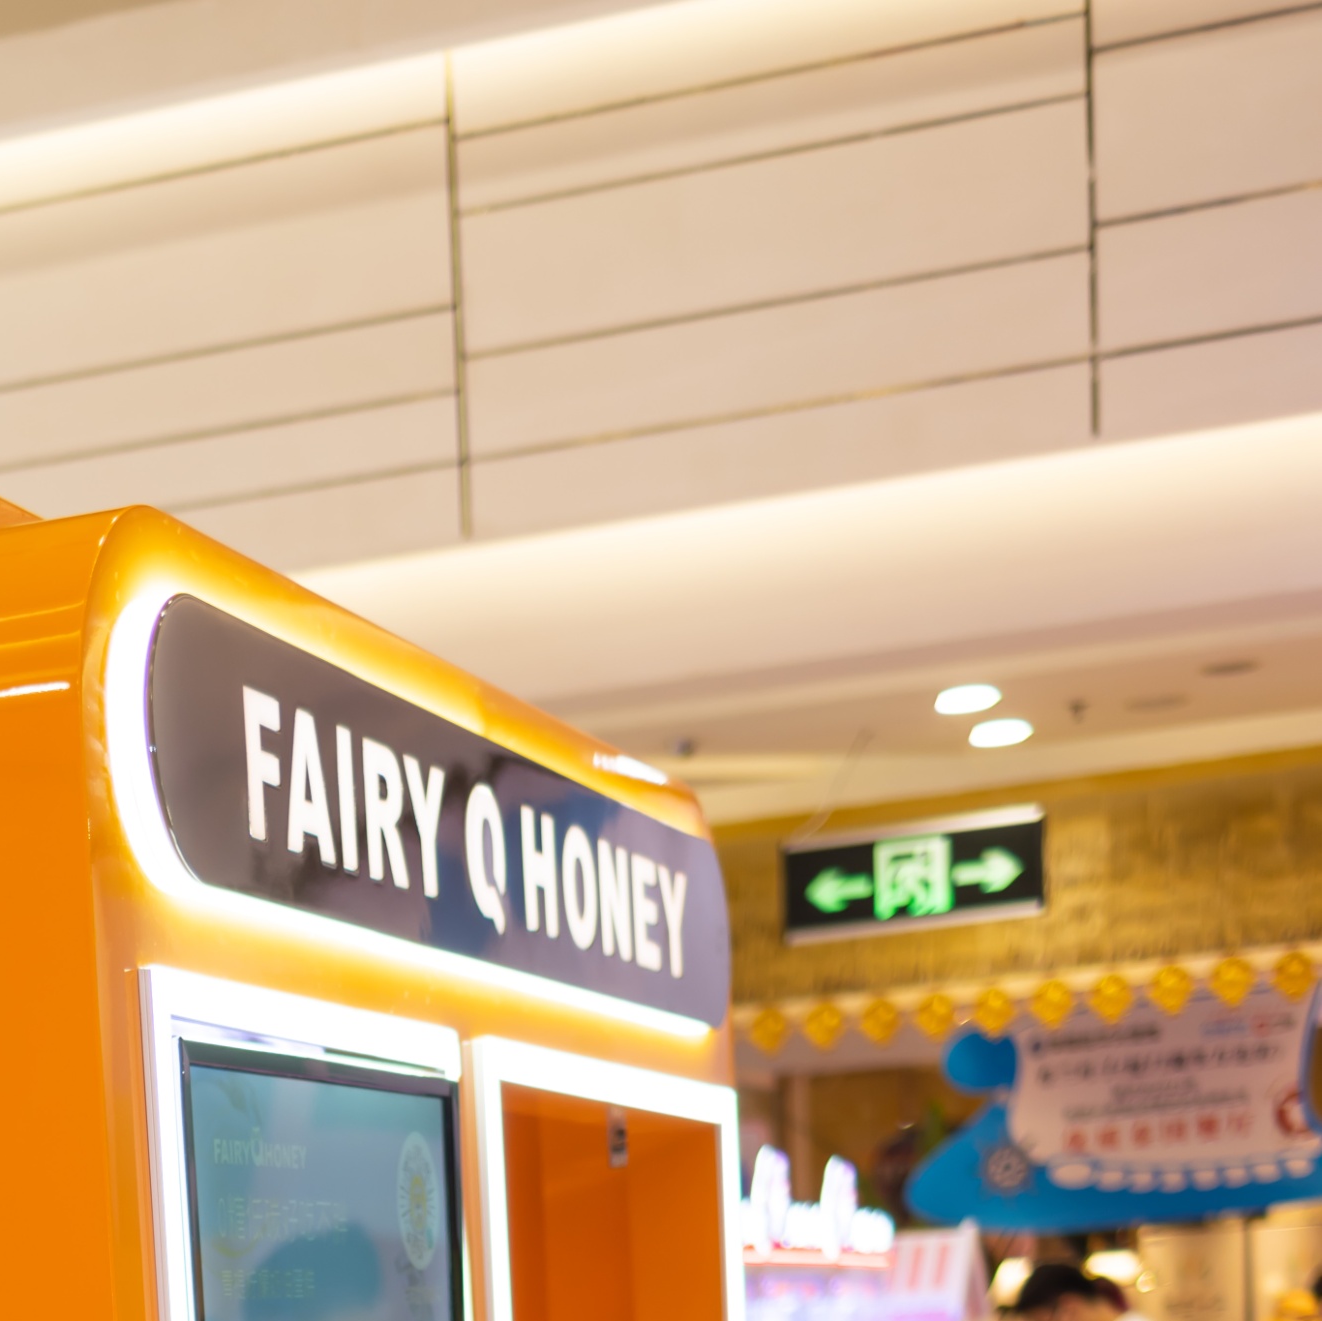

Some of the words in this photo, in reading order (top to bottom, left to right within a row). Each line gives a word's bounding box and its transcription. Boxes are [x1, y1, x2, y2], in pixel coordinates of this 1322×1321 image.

[242, 683, 445, 899] FAIRY
[465, 783, 507, 935] Q
[520, 804, 688, 979] HONEY
